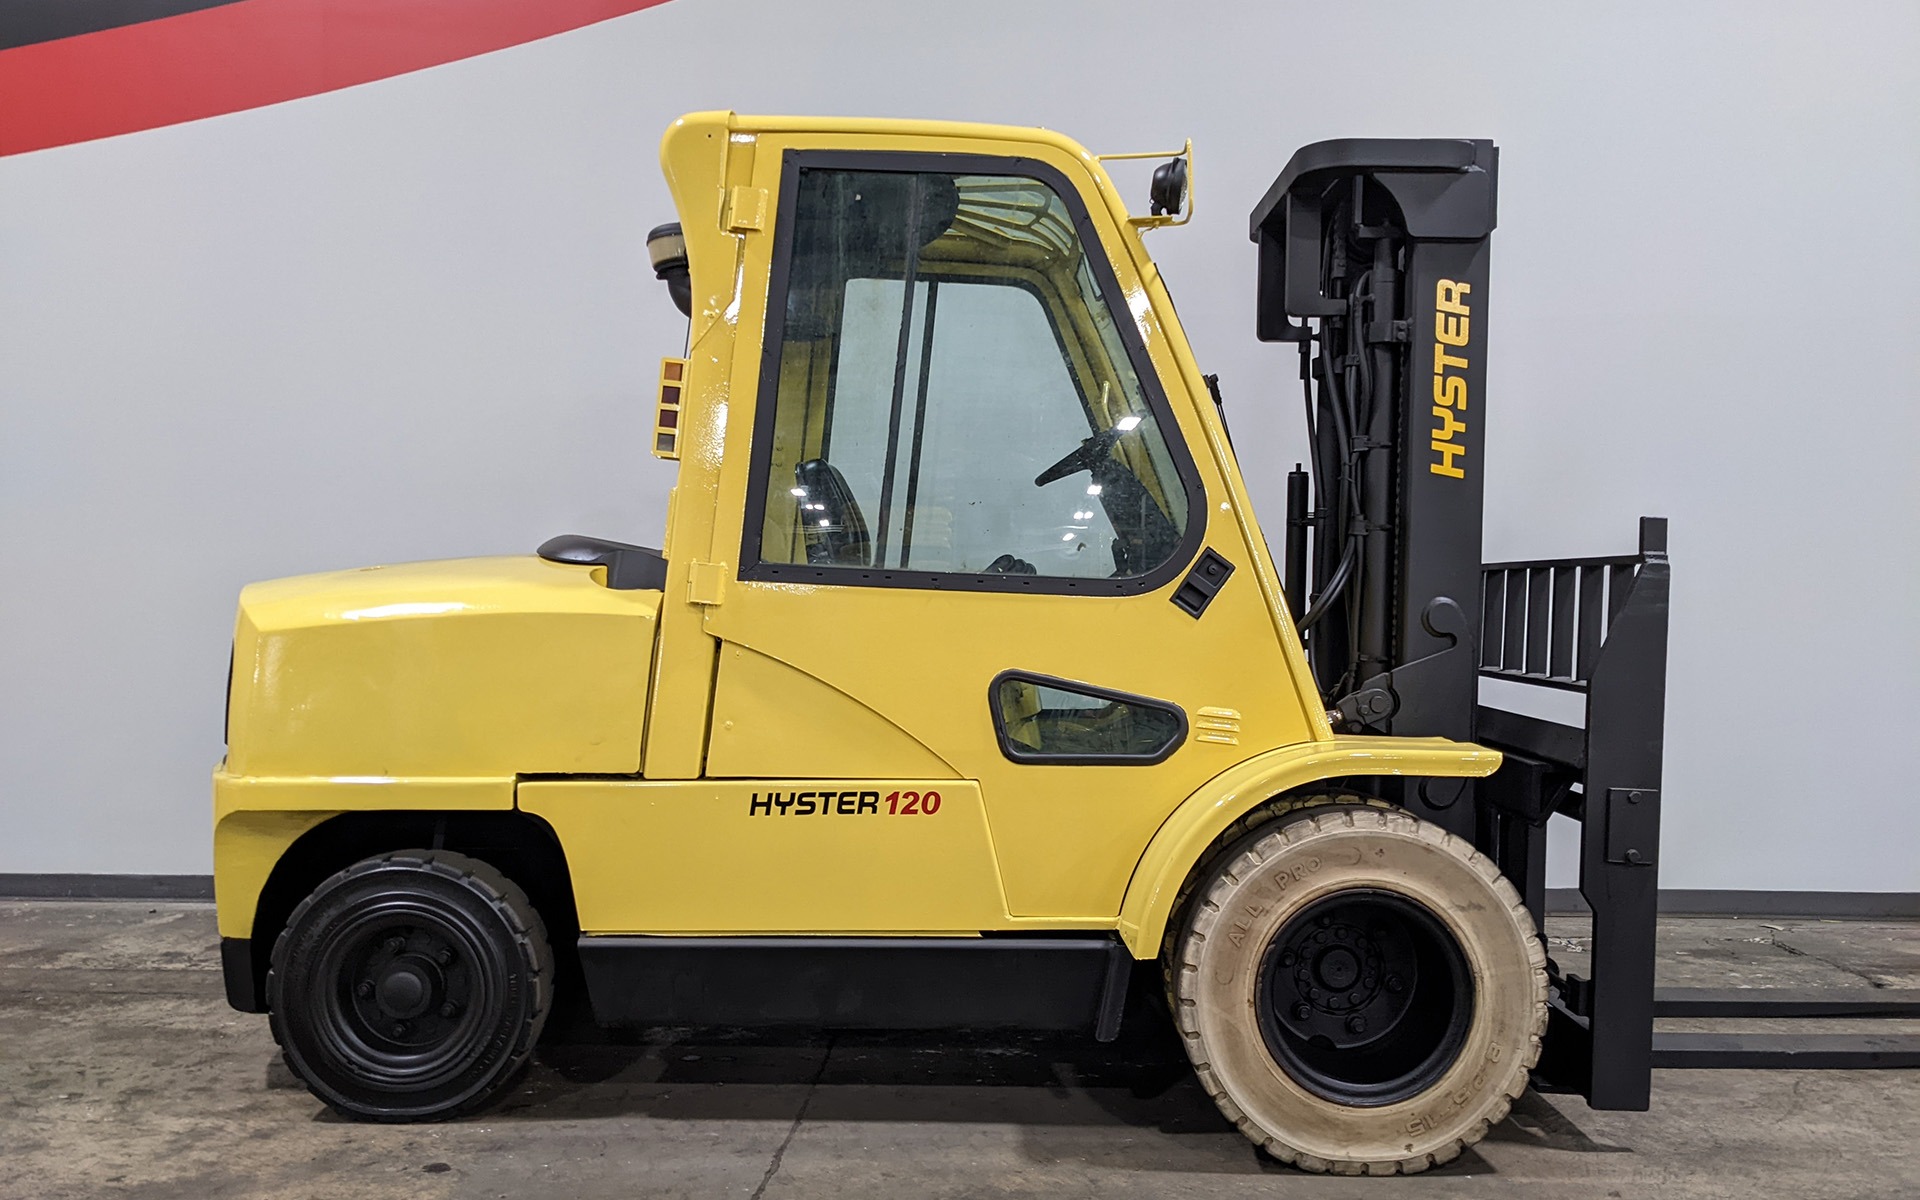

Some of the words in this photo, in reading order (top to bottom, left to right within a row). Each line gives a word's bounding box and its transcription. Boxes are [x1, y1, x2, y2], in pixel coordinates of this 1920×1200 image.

[1430, 278, 1471, 479] HYSTER
[749, 791, 880, 816] HYSTER
[885, 791, 942, 816] 120
[1228, 904, 1264, 948] ALL
[1274, 857, 1322, 891] PRO
